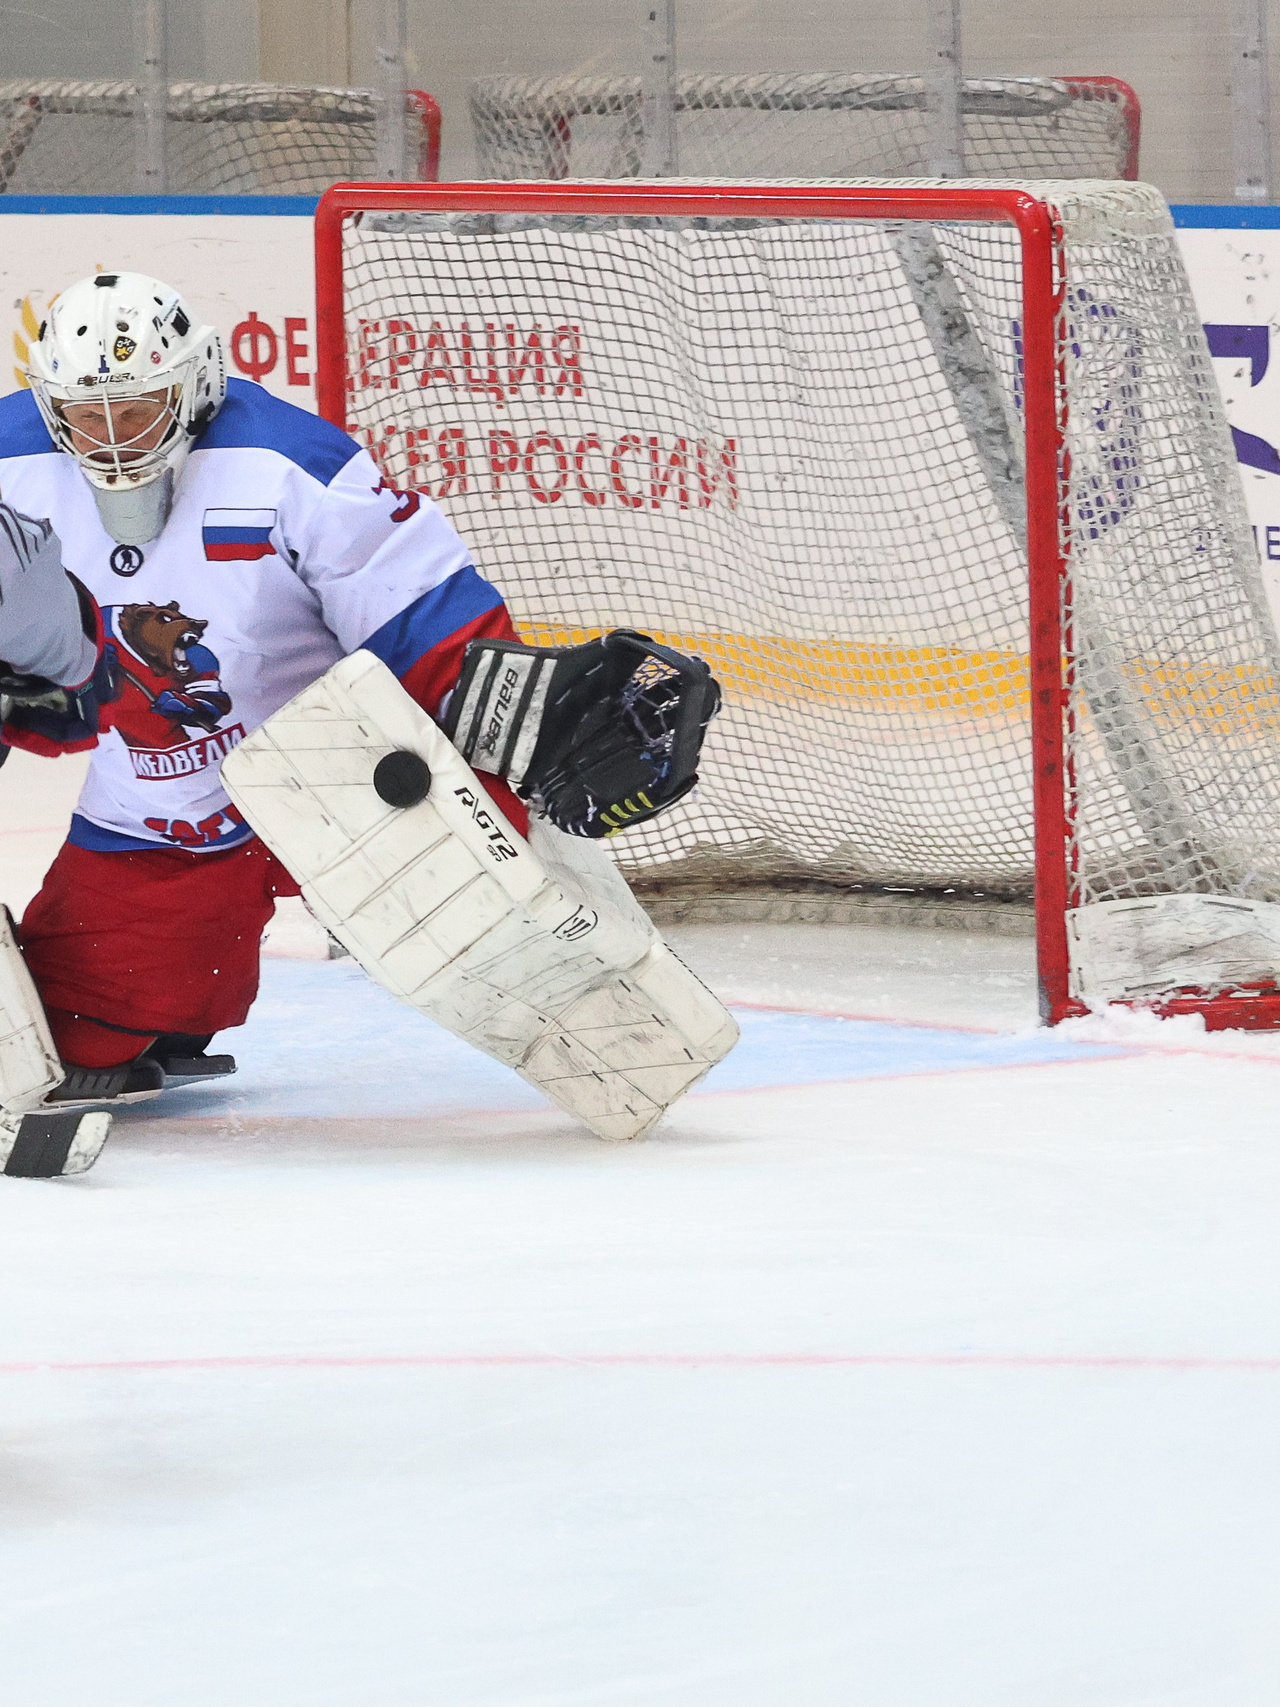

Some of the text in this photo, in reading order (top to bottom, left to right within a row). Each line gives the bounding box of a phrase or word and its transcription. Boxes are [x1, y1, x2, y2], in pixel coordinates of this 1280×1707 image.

[231, 311, 583, 409] ФЕЕРАЦИЯ
[489, 428, 737, 510] РОССИИ
[482, 667, 518, 757] BAUER
